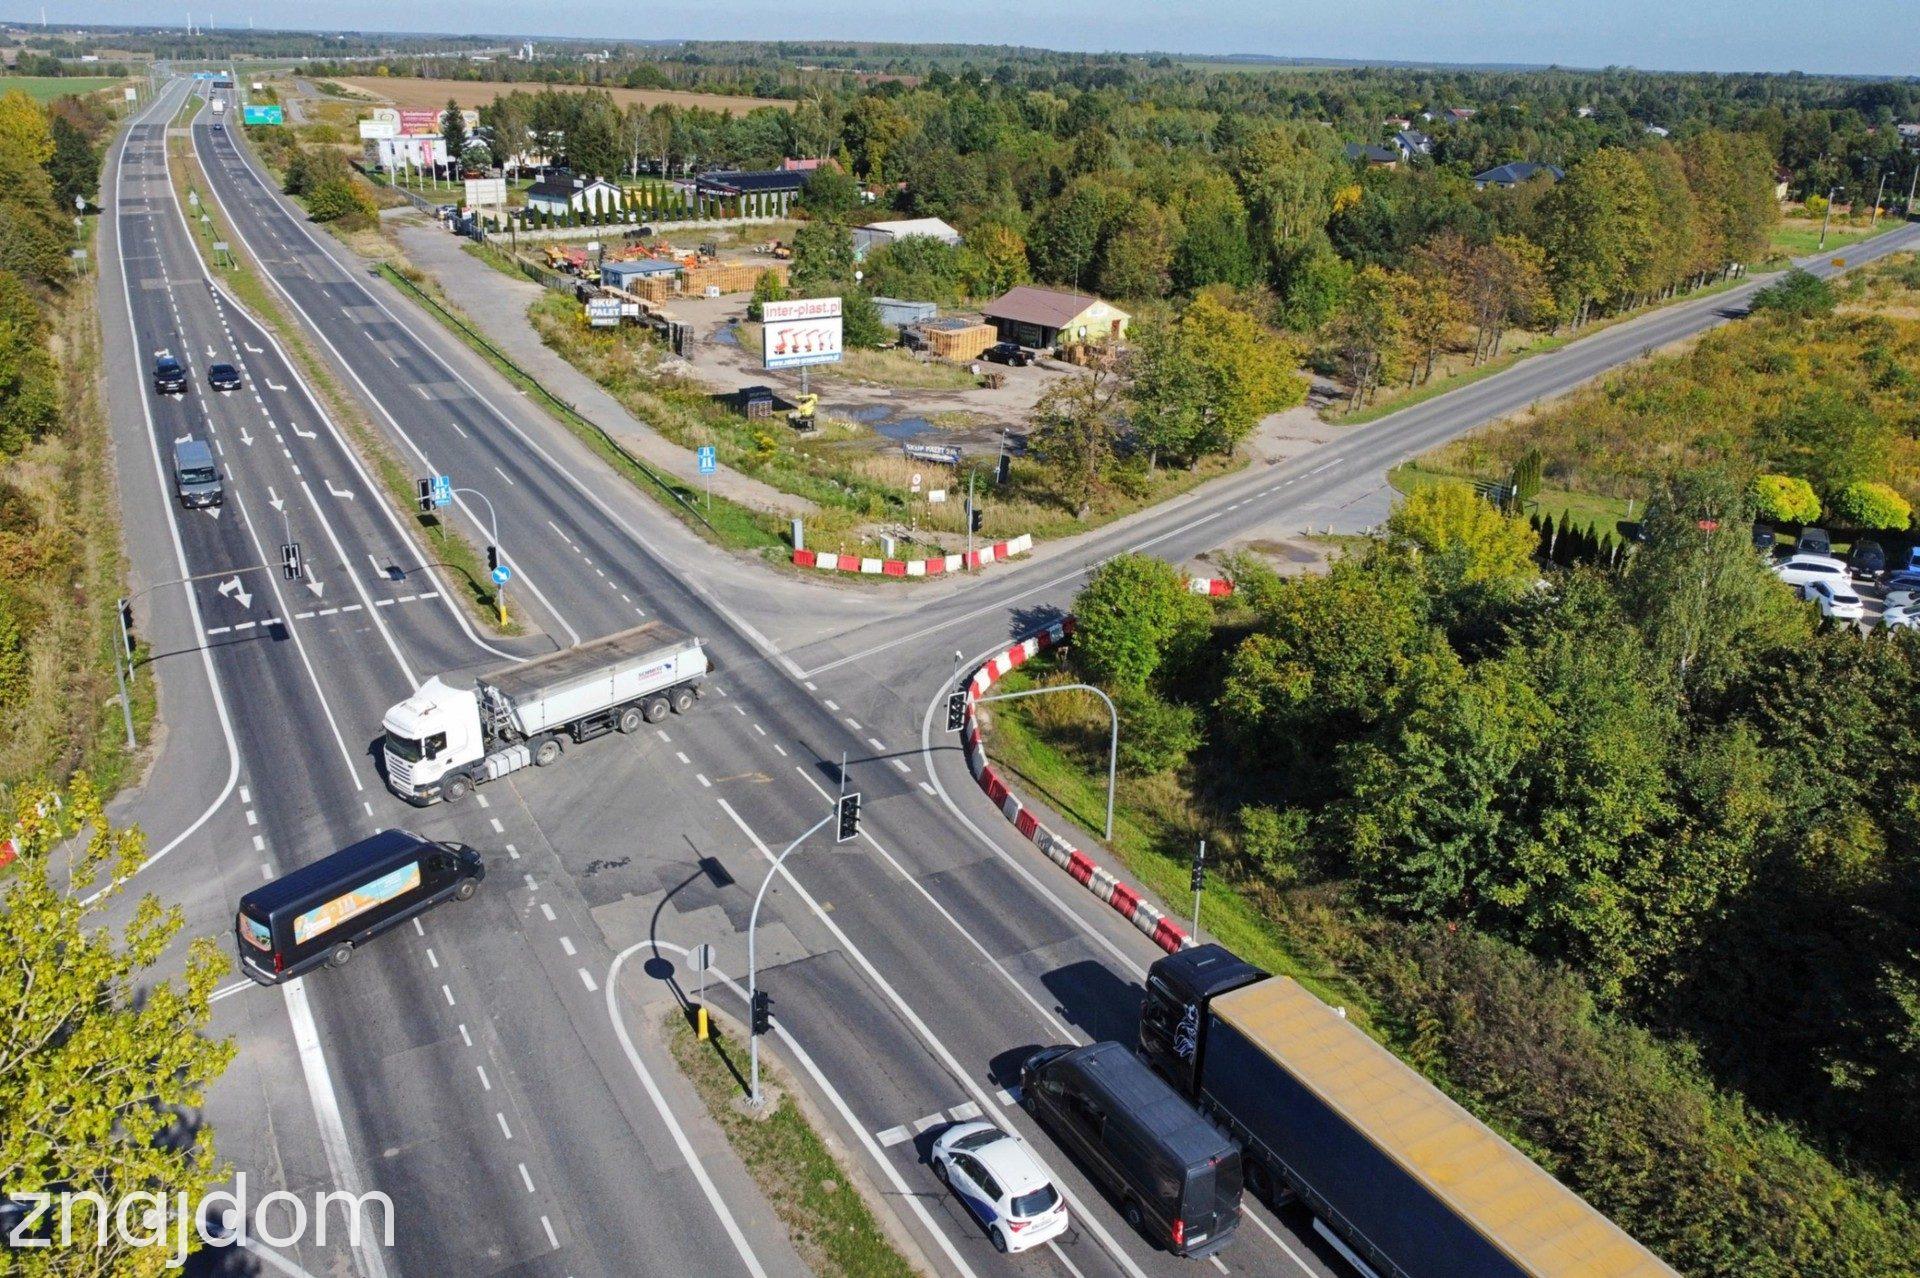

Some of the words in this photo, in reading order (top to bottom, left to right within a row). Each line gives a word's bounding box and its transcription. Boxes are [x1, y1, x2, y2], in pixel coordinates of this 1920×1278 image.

[591, 298, 619, 307] SKUP
[591, 308, 620, 317] PALET
[766, 300, 841, 318] inter-plast.pl
[906, 443, 924, 451] SKUP
[925, 446, 945, 454] PALET
